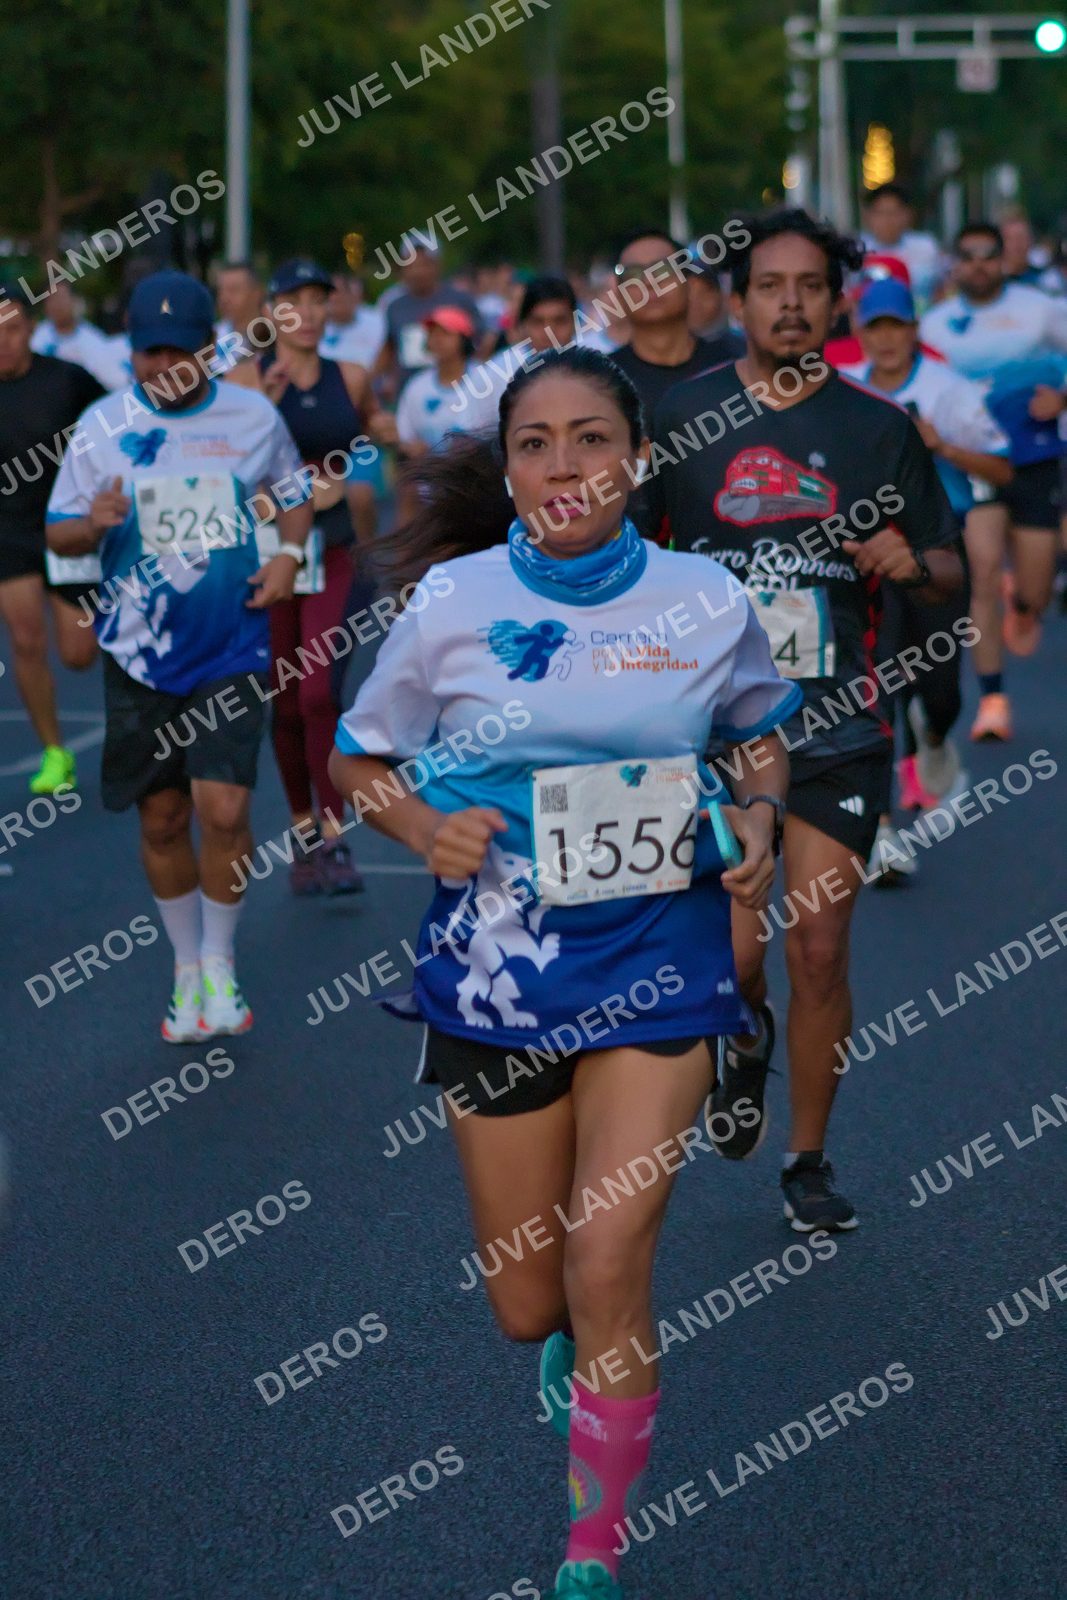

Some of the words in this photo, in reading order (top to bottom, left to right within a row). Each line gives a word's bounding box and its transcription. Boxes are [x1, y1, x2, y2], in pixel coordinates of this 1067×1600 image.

[156, 504, 223, 544] 526
[620, 658, 699, 673] Integridad
[635, 645, 671, 657] Vida
[774, 629, 800, 667] 4
[549, 812, 696, 884] 1556
